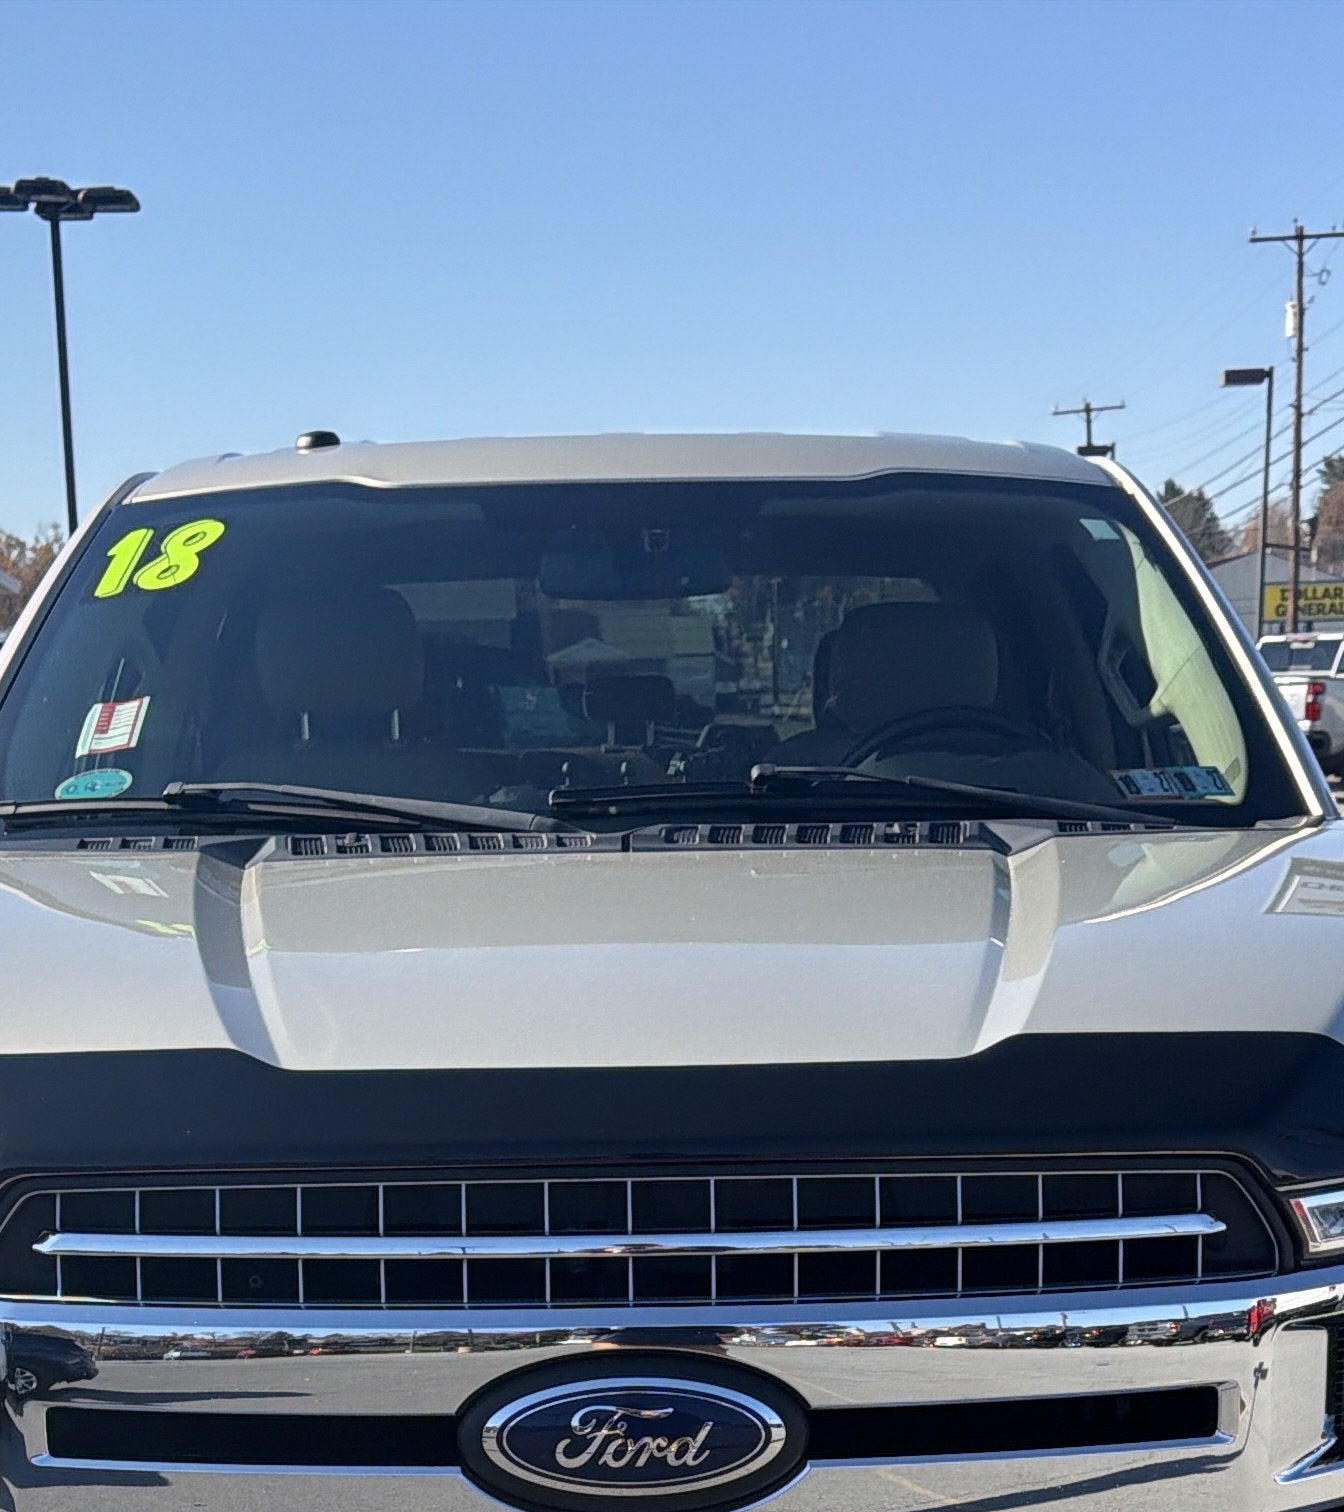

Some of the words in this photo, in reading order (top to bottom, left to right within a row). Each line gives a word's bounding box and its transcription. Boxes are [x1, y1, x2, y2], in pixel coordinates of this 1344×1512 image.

[93, 519, 226, 598] 18
[1279, 586, 1344, 602] DLLAR
[555, 1405, 714, 1468] Ford
